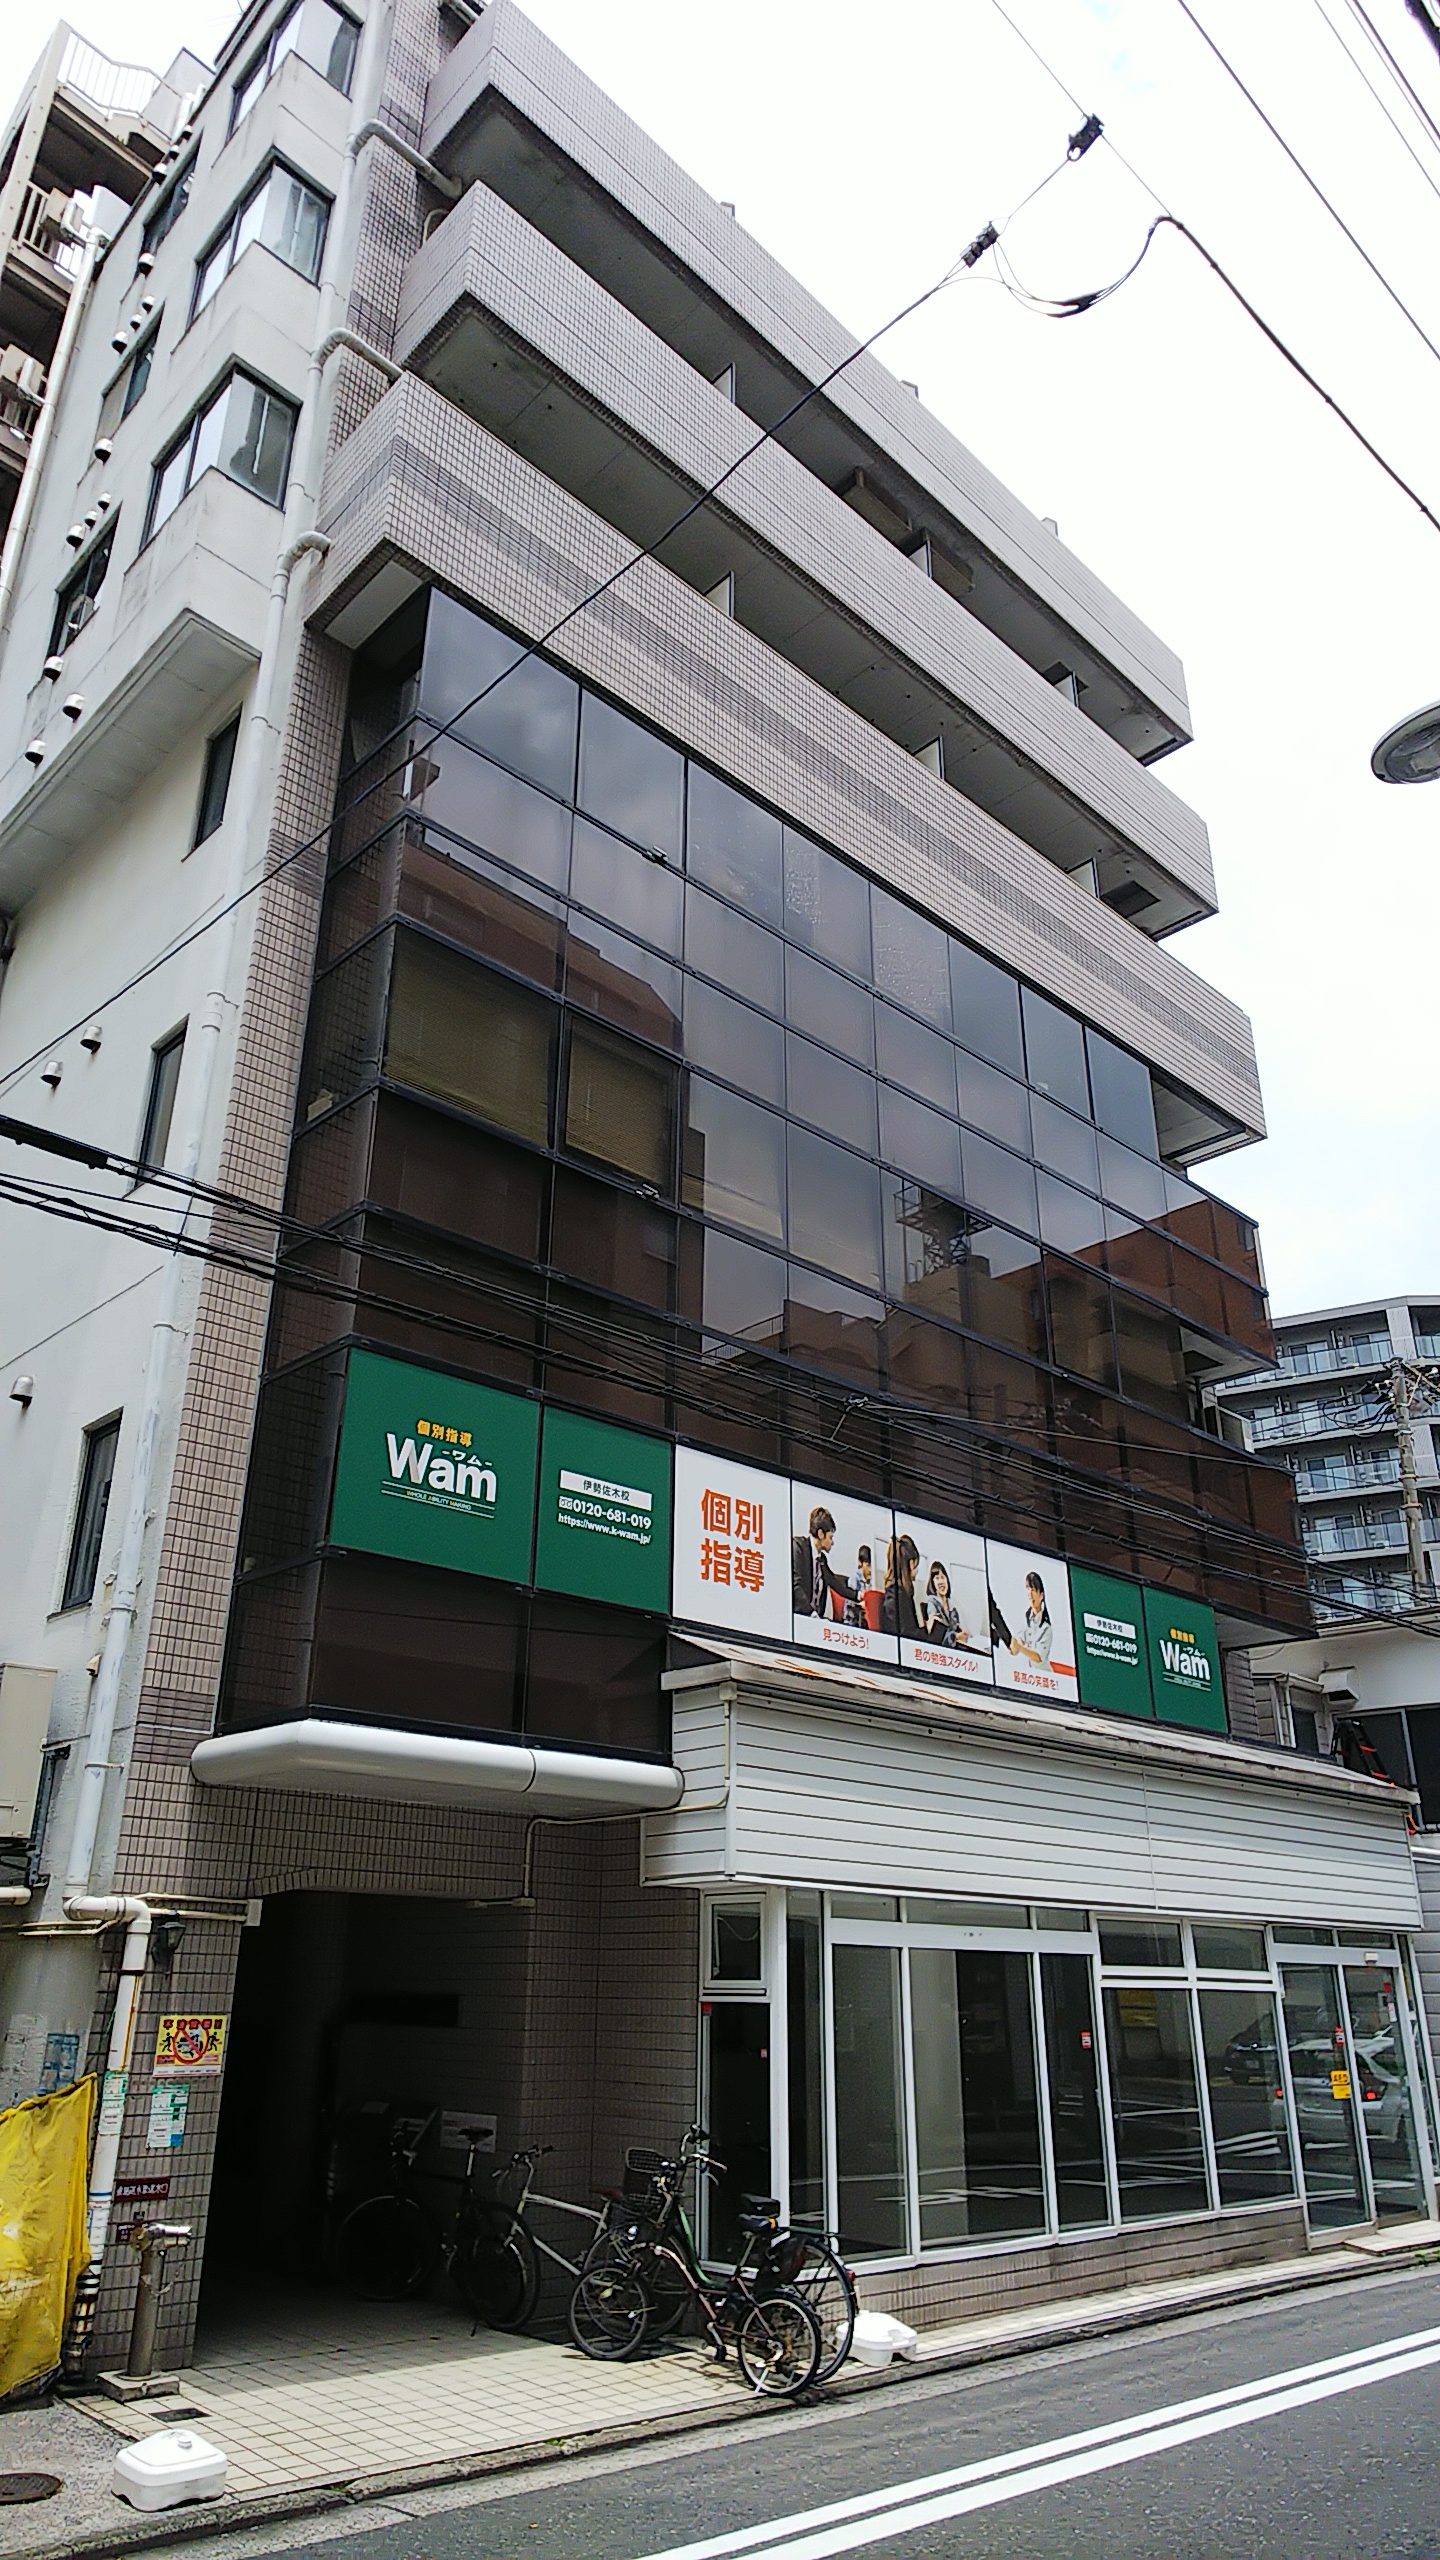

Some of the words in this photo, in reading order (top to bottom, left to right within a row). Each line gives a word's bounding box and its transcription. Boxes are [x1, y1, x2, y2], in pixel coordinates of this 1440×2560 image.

[416, 1420, 473, 1447] 個別指導
[386, 1432, 497, 1502] Wam
[406, 1489, 427, 1500] WHOLE
[428, 1495, 449, 1505] ABILITY
[449, 1500, 472, 1511] MAKING
[583, 1480, 630, 1501] 伊勢佐木校
[558, 1513, 652, 1544] https://www.k-wam.jp/
[573, 1500, 651, 1529] 0120-681-019
[700, 1488, 764, 1545] 個別
[700, 1538, 765, 1593] 指導
[1159, 1639, 1211, 1680] Wam
